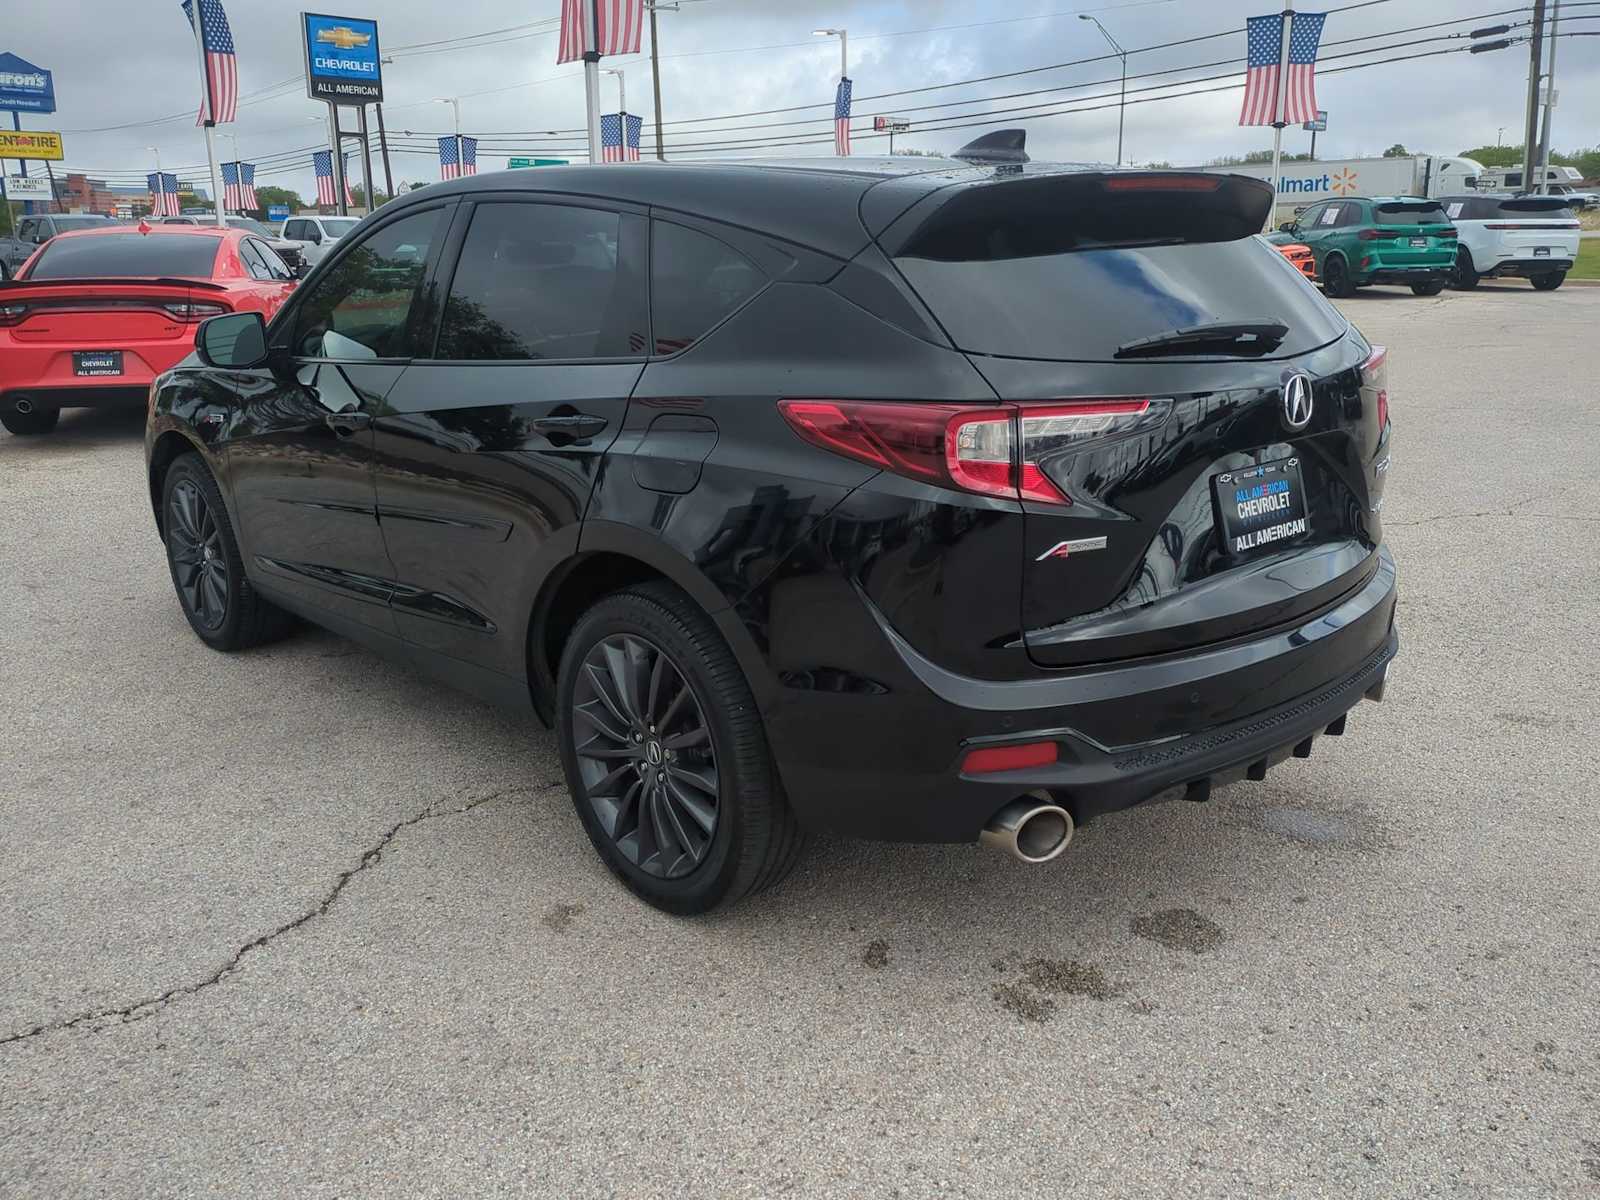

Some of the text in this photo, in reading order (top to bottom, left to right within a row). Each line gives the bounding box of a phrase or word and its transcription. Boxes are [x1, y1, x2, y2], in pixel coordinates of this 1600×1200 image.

[315, 58, 376, 72] CHEVROLET
[318, 83, 379, 96] ALL AMERICAN
[29, 136, 57, 148] TIRE
[1236, 480, 1289, 502] ALL AMERICAN
[1237, 492, 1290, 519] CHEVROLET
[1236, 518, 1306, 552] ALL AMERICAN
